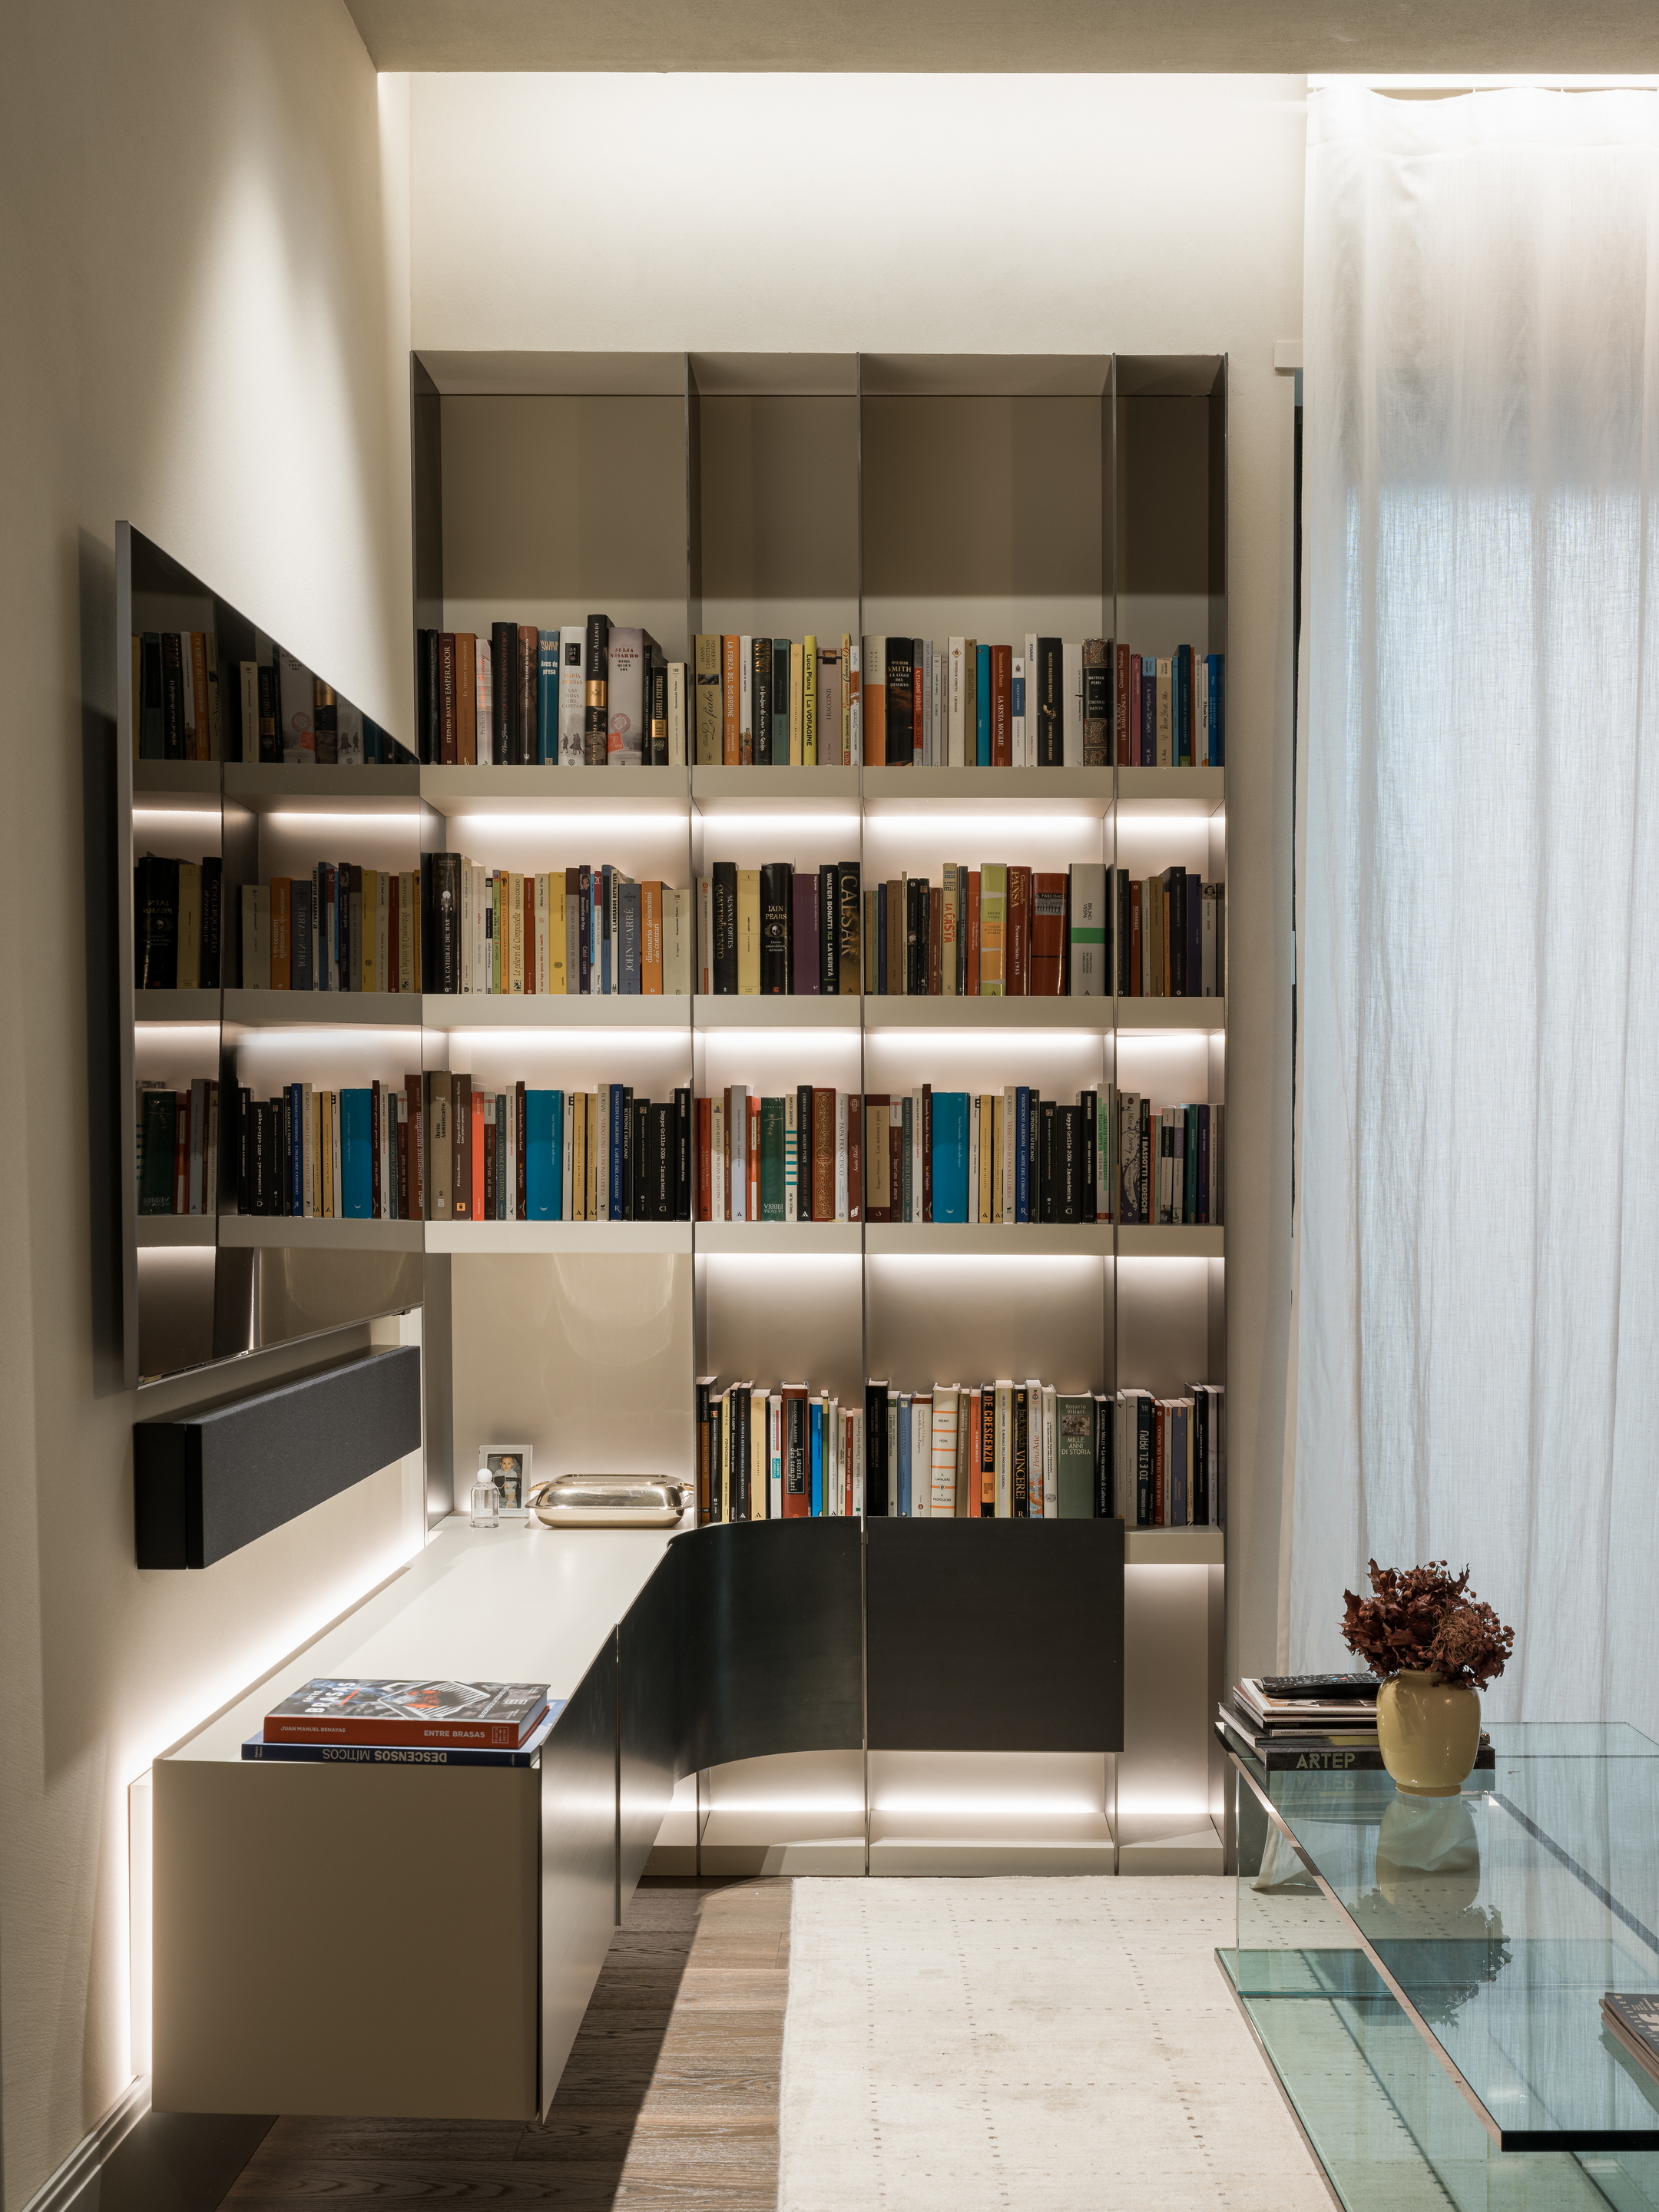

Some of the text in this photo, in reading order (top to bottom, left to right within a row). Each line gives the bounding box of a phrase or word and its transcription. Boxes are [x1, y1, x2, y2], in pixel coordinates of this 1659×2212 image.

[754, 644, 765, 672] KING
[806, 700, 812, 708] La
[1011, 871, 1020, 908] PANSA
[513, 912, 523, 943] Compostelle
[624, 908, 634, 940] CARRÉ
[715, 884, 724, 959] QUATTROCENTO
[841, 876, 858, 956] CAESAR
[944, 912, 956, 943] CASTA
[827, 931, 833, 940] K2
[827, 943, 833, 951] LA
[626, 947, 634, 971] JOHN
[984, 1396, 993, 1462] DE CRESCENZO
[1140, 1430, 1149, 1450] PAPU
[1140, 1452, 1149, 1462] IL
[789, 1461, 797, 1491] templari
[1016, 1450, 1025, 1499] VINCERE!
[1139, 1470, 1148, 1481] IO
[302, 1690, 323, 1702] ENTRE
[305, 1682, 356, 1712] BRASAS
[323, 1748, 447, 1763] DESCENSOS MÍTICOS
